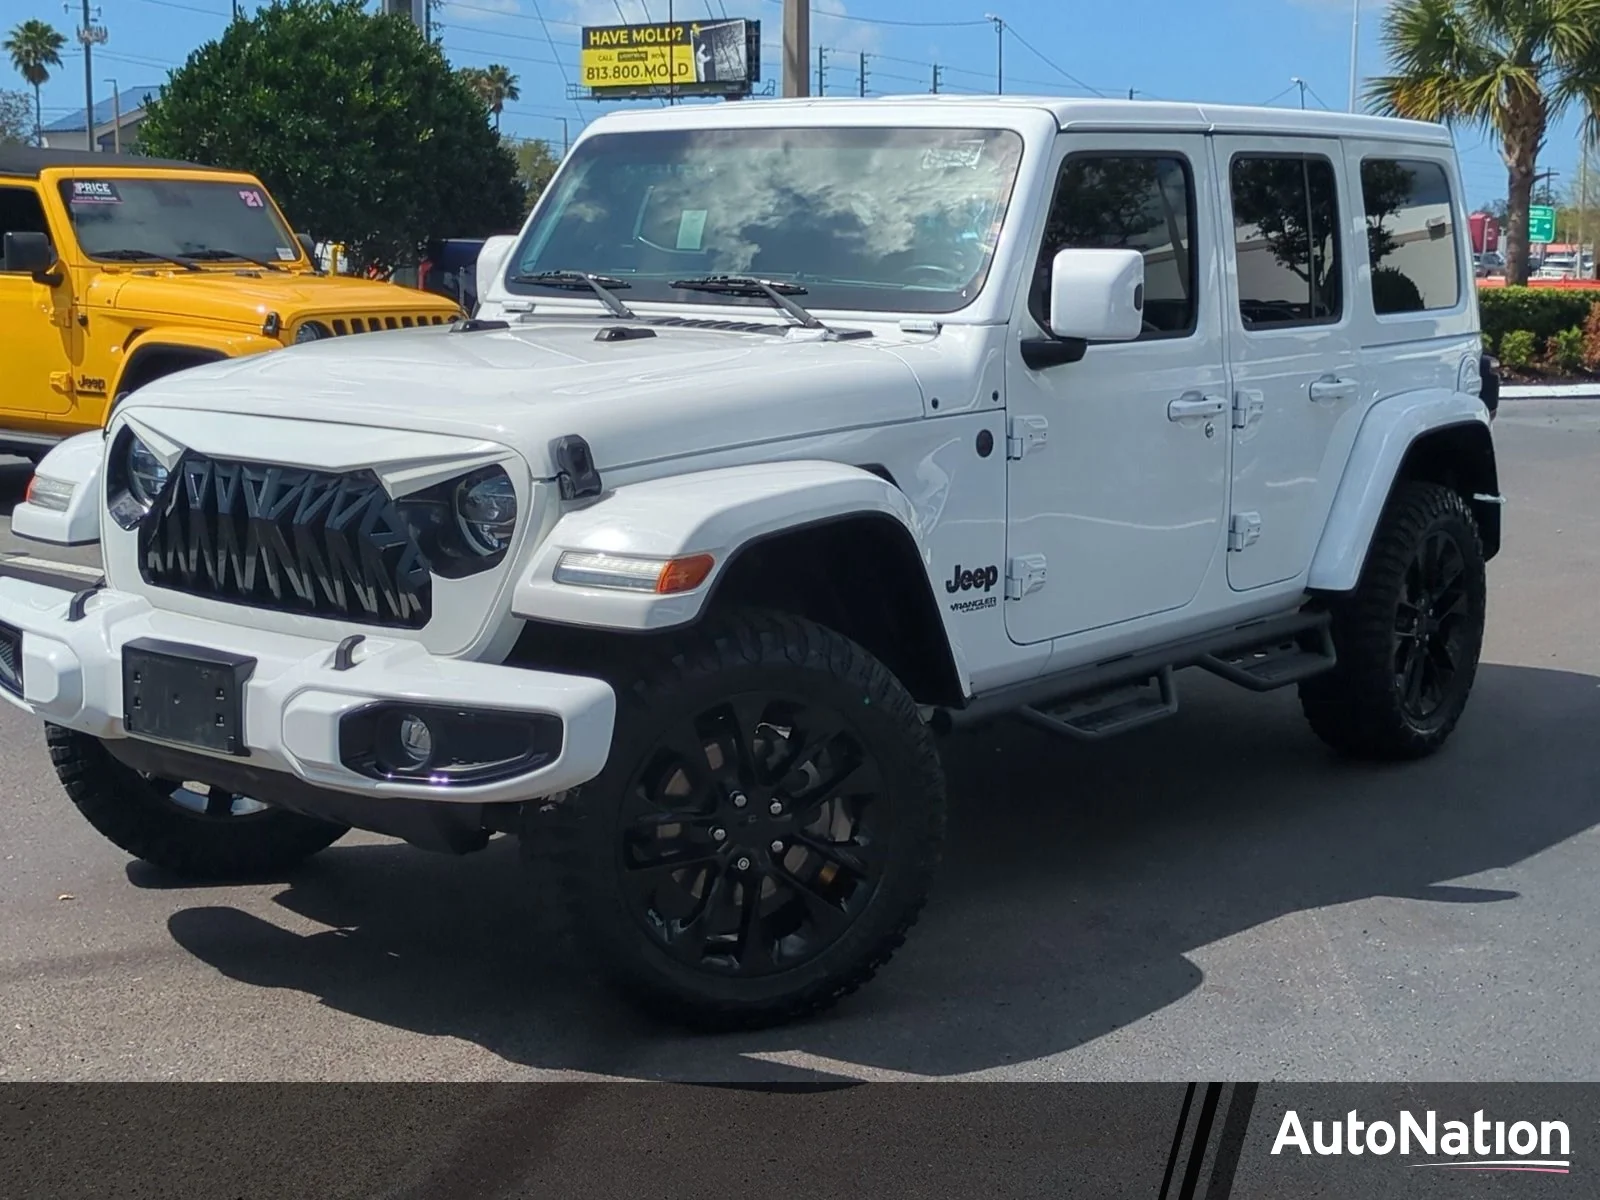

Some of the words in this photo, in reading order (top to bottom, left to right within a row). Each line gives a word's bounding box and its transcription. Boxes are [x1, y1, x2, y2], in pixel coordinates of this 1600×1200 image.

[589, 30, 628, 45] HAVE
[632, 27, 683, 43] MOLD?
[78, 374, 105, 390] Jeep
[945, 565, 998, 593] Jeep
[950, 597, 996, 611] WRANGLER
